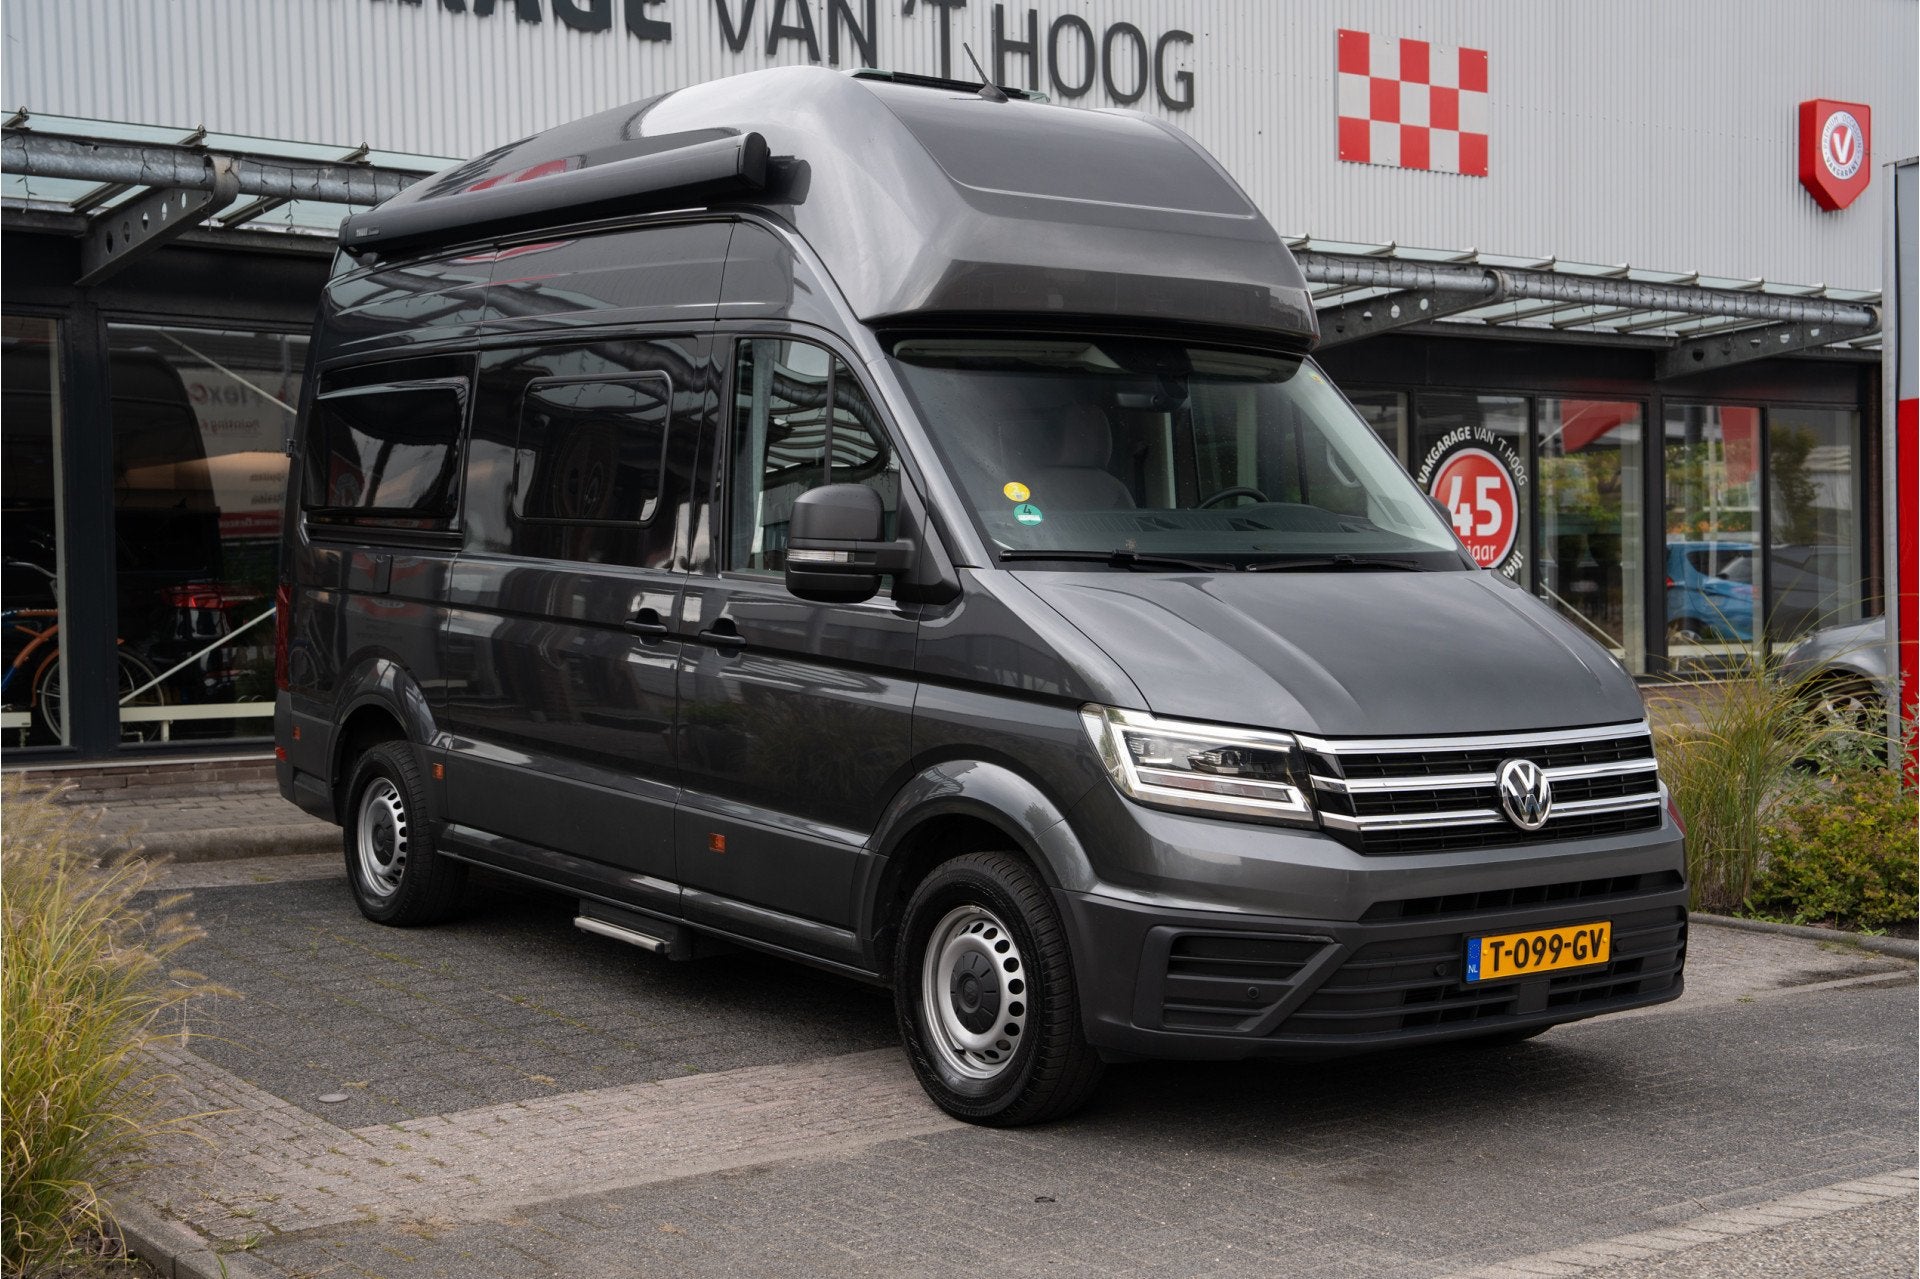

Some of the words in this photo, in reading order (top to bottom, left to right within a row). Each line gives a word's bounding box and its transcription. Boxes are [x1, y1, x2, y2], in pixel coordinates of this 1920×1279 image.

[714, 0, 878, 69] VAN
[994, 2, 1195, 111] HOOG
[1417, 426, 1472, 485] VAKGARAGE
[1474, 426, 1495, 445] VAN
[1504, 447, 1529, 487] HOOG
[1023, 504, 1032, 515] 4
[1447, 476, 1502, 537] 45
[1467, 964, 1478, 974] NL
[1490, 928, 1604, 972] T-099-GV
